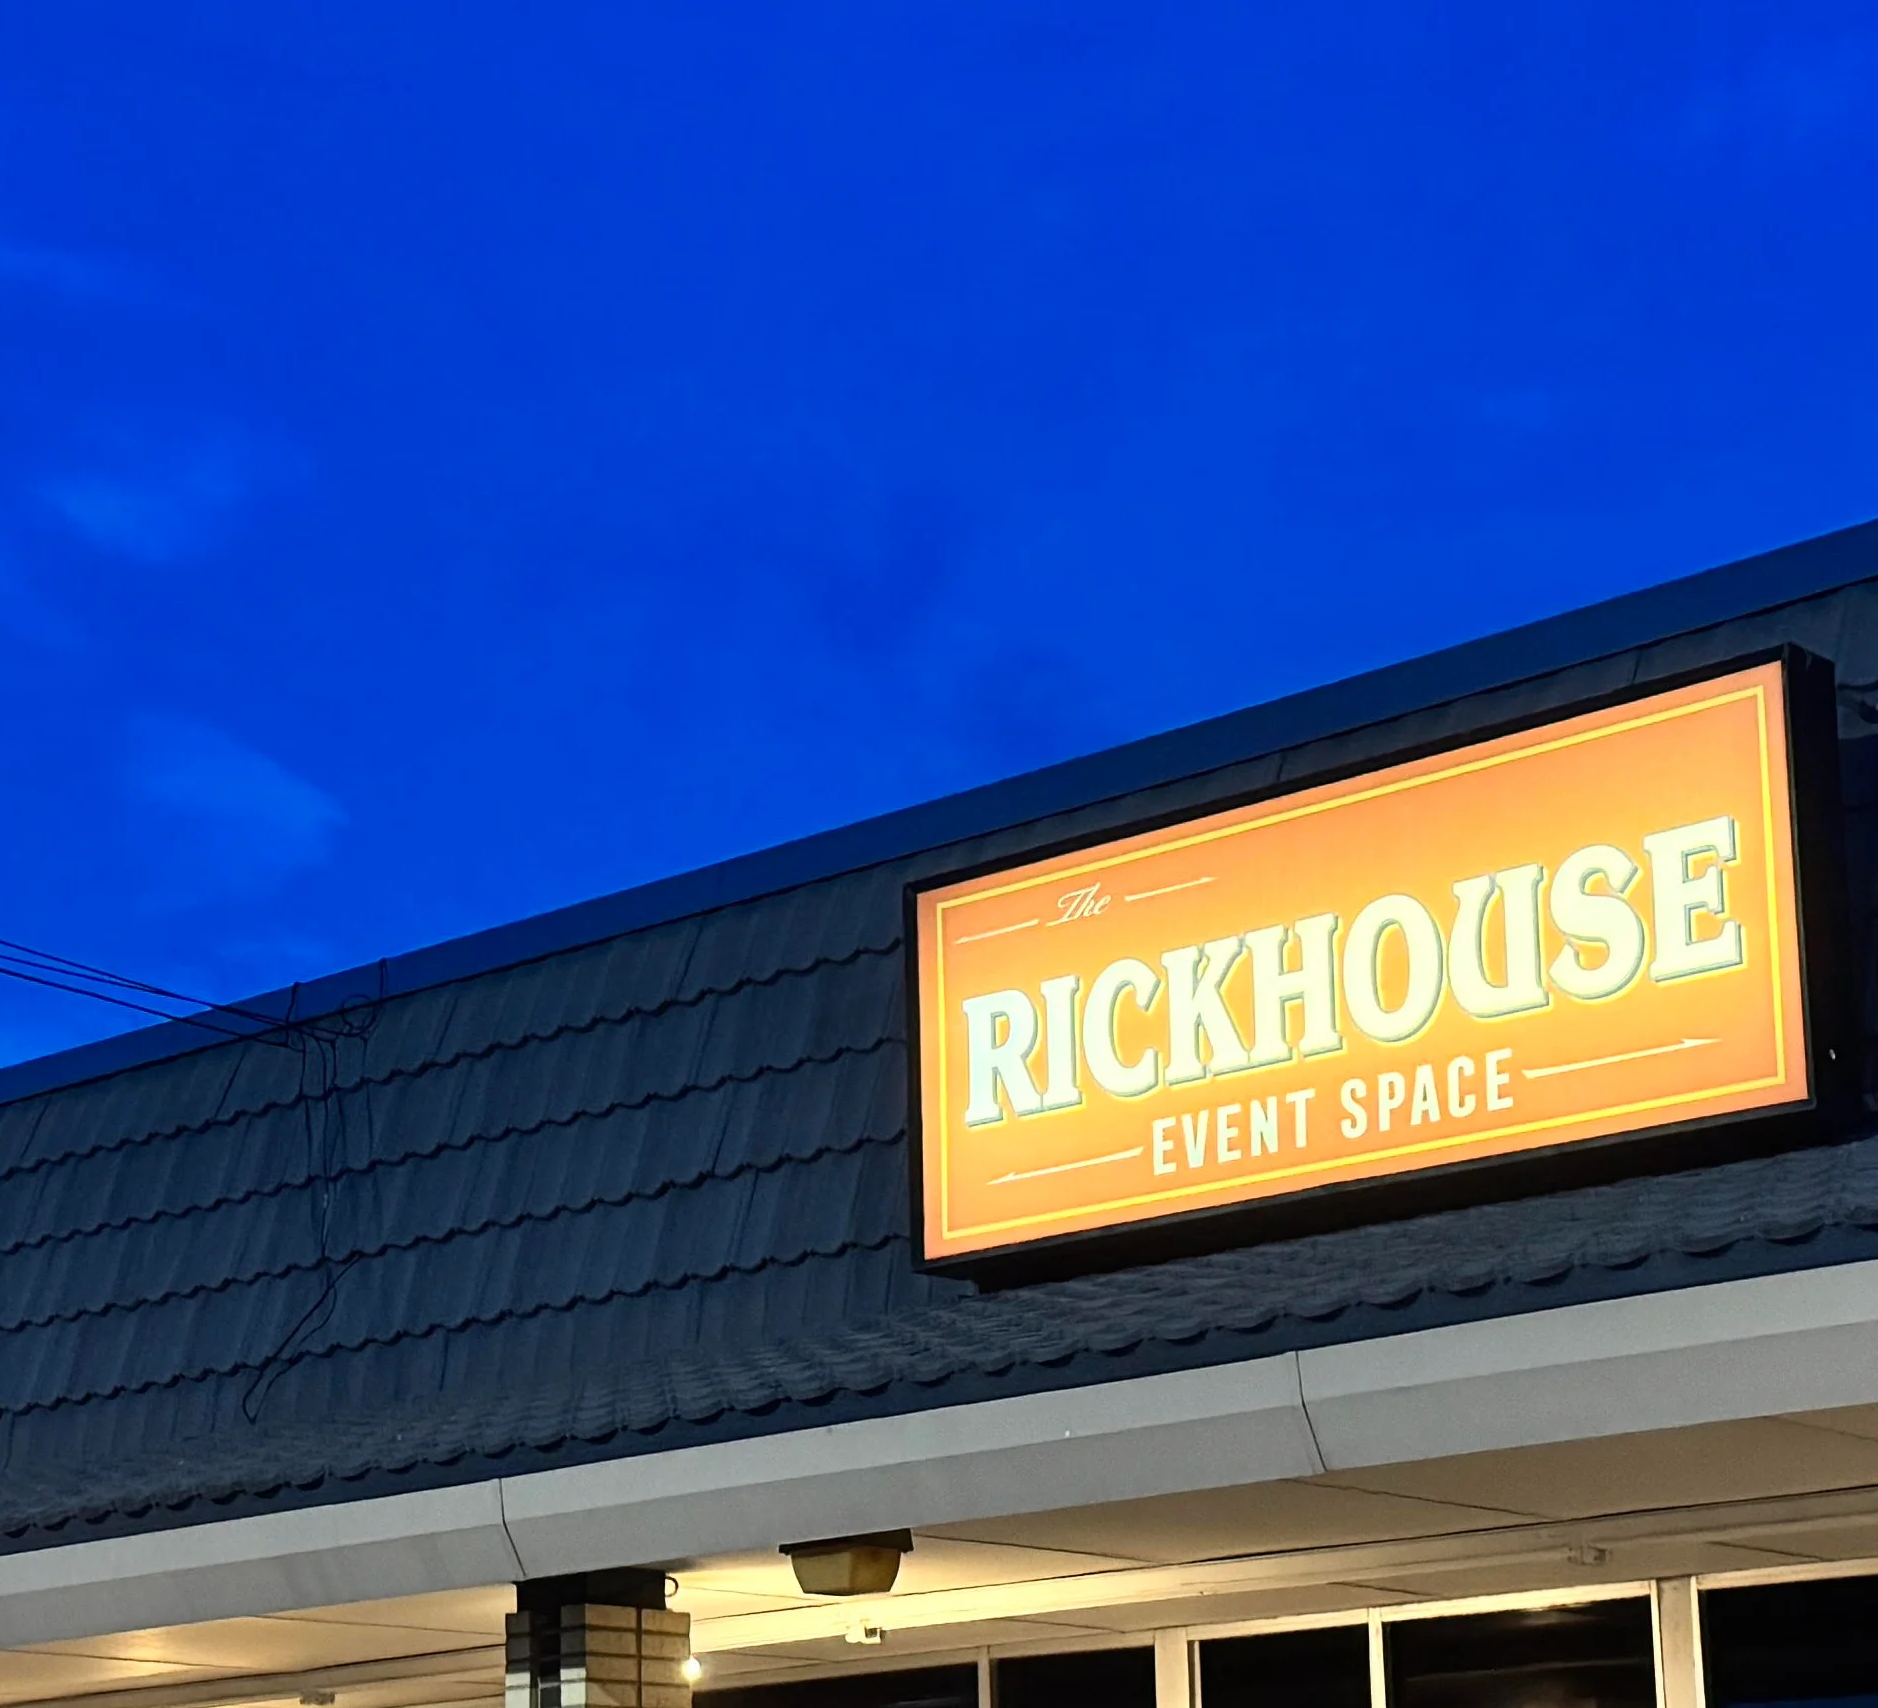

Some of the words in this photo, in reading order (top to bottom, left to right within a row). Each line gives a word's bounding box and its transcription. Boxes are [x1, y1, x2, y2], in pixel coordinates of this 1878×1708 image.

[1045, 882, 1111, 927] The
[962, 815, 1743, 1128] RICKHOUSE
[1152, 1087, 1316, 1176] EVENT
[1340, 1047, 1514, 1140] SPACE
